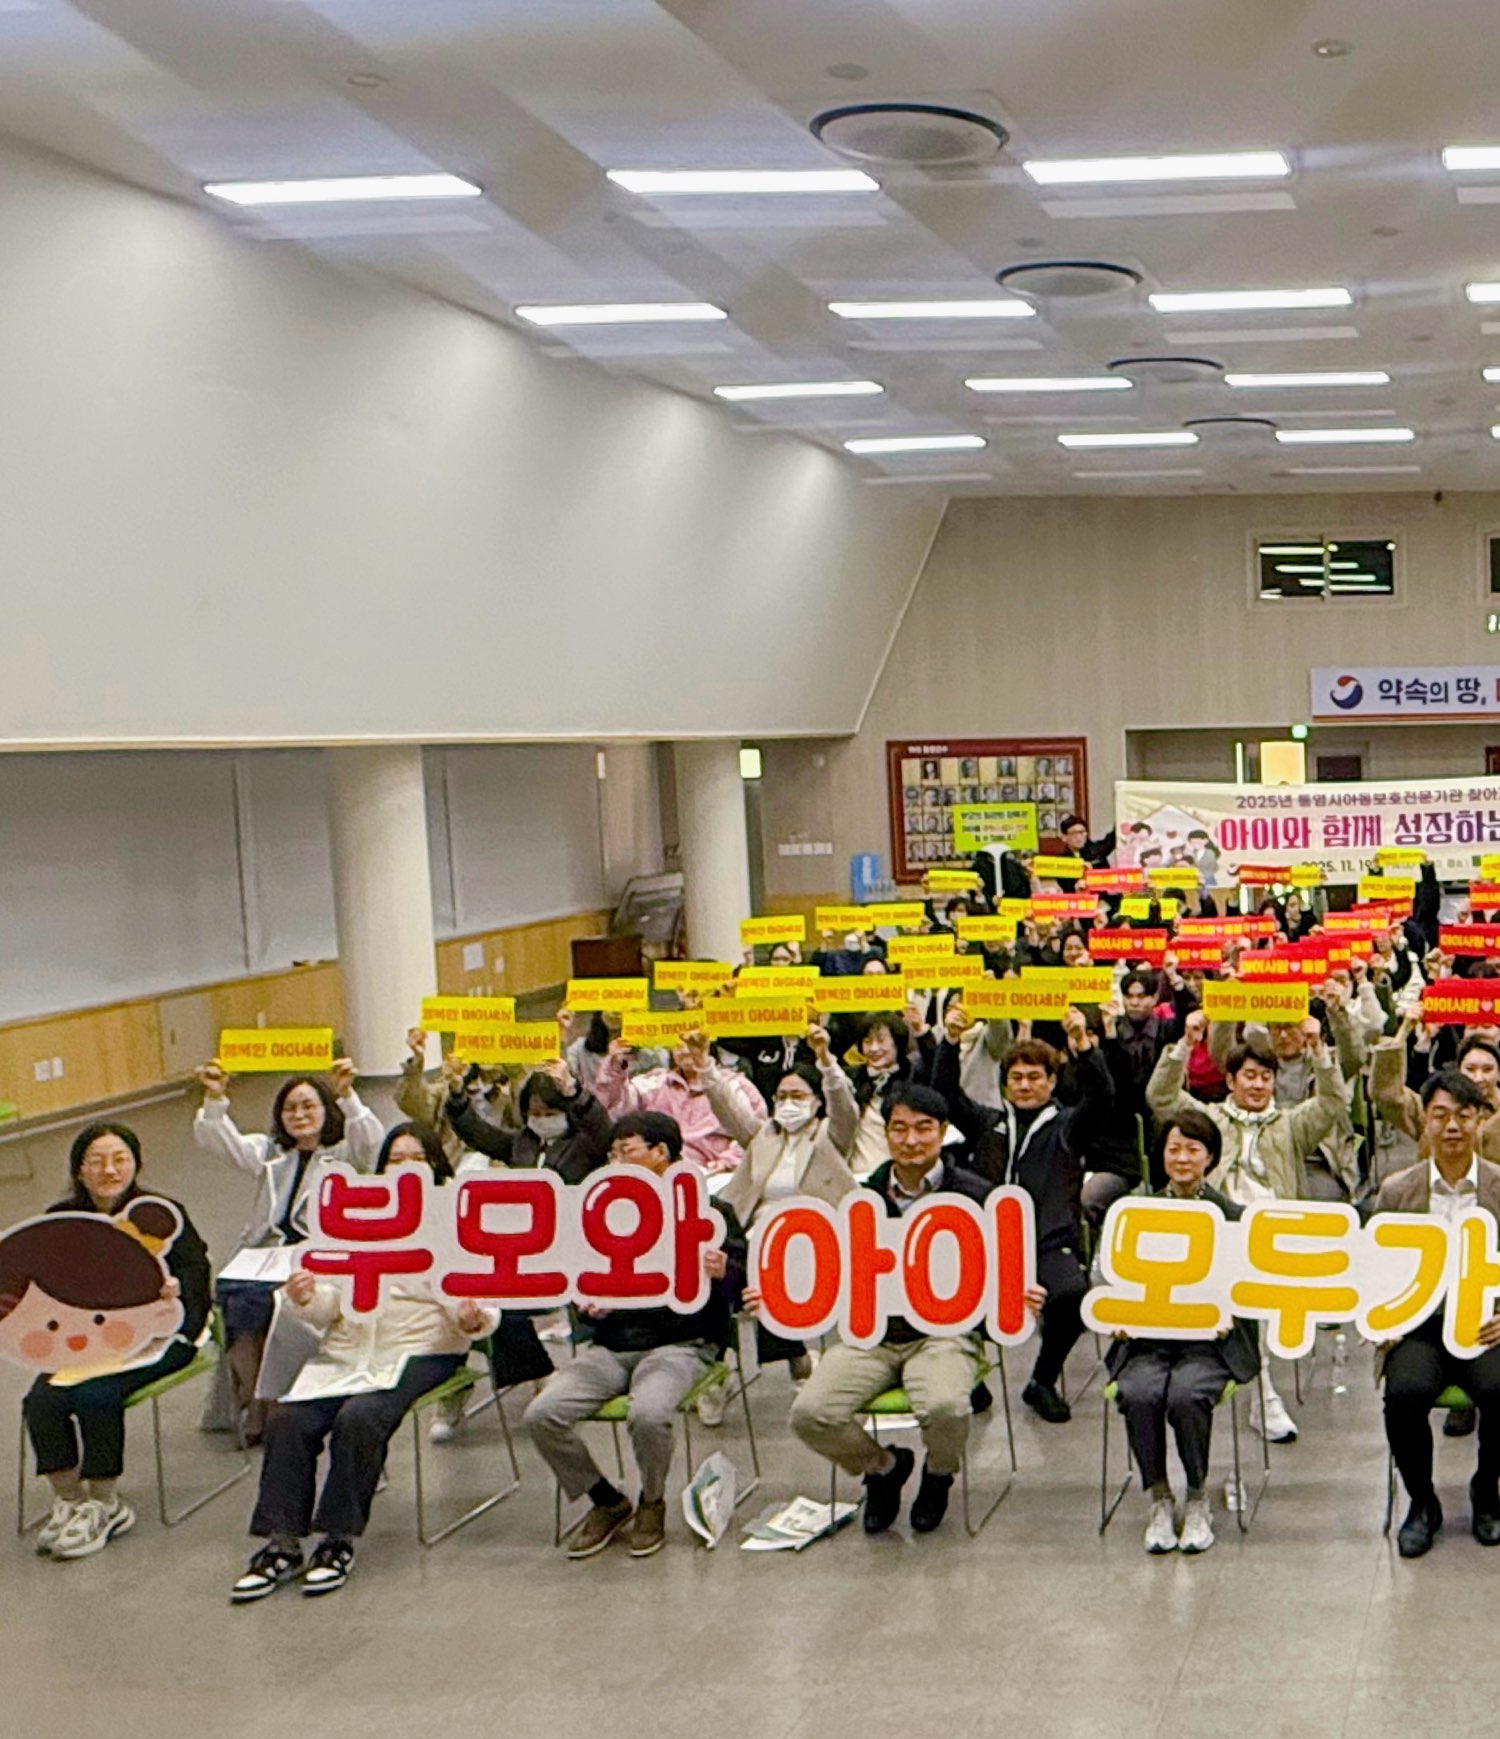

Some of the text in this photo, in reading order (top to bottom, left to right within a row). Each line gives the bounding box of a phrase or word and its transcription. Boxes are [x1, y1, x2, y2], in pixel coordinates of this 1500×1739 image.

[1378, 677, 1449, 705] 약속의
[1456, 676, 1487, 706] 땅,
[1236, 795, 1293, 808] 2025년
[1221, 816, 1312, 852] 아이와
[1322, 813, 1382, 848] 함께
[302, 1171, 715, 1313] 부모와
[758, 1197, 1024, 1339] 아이
